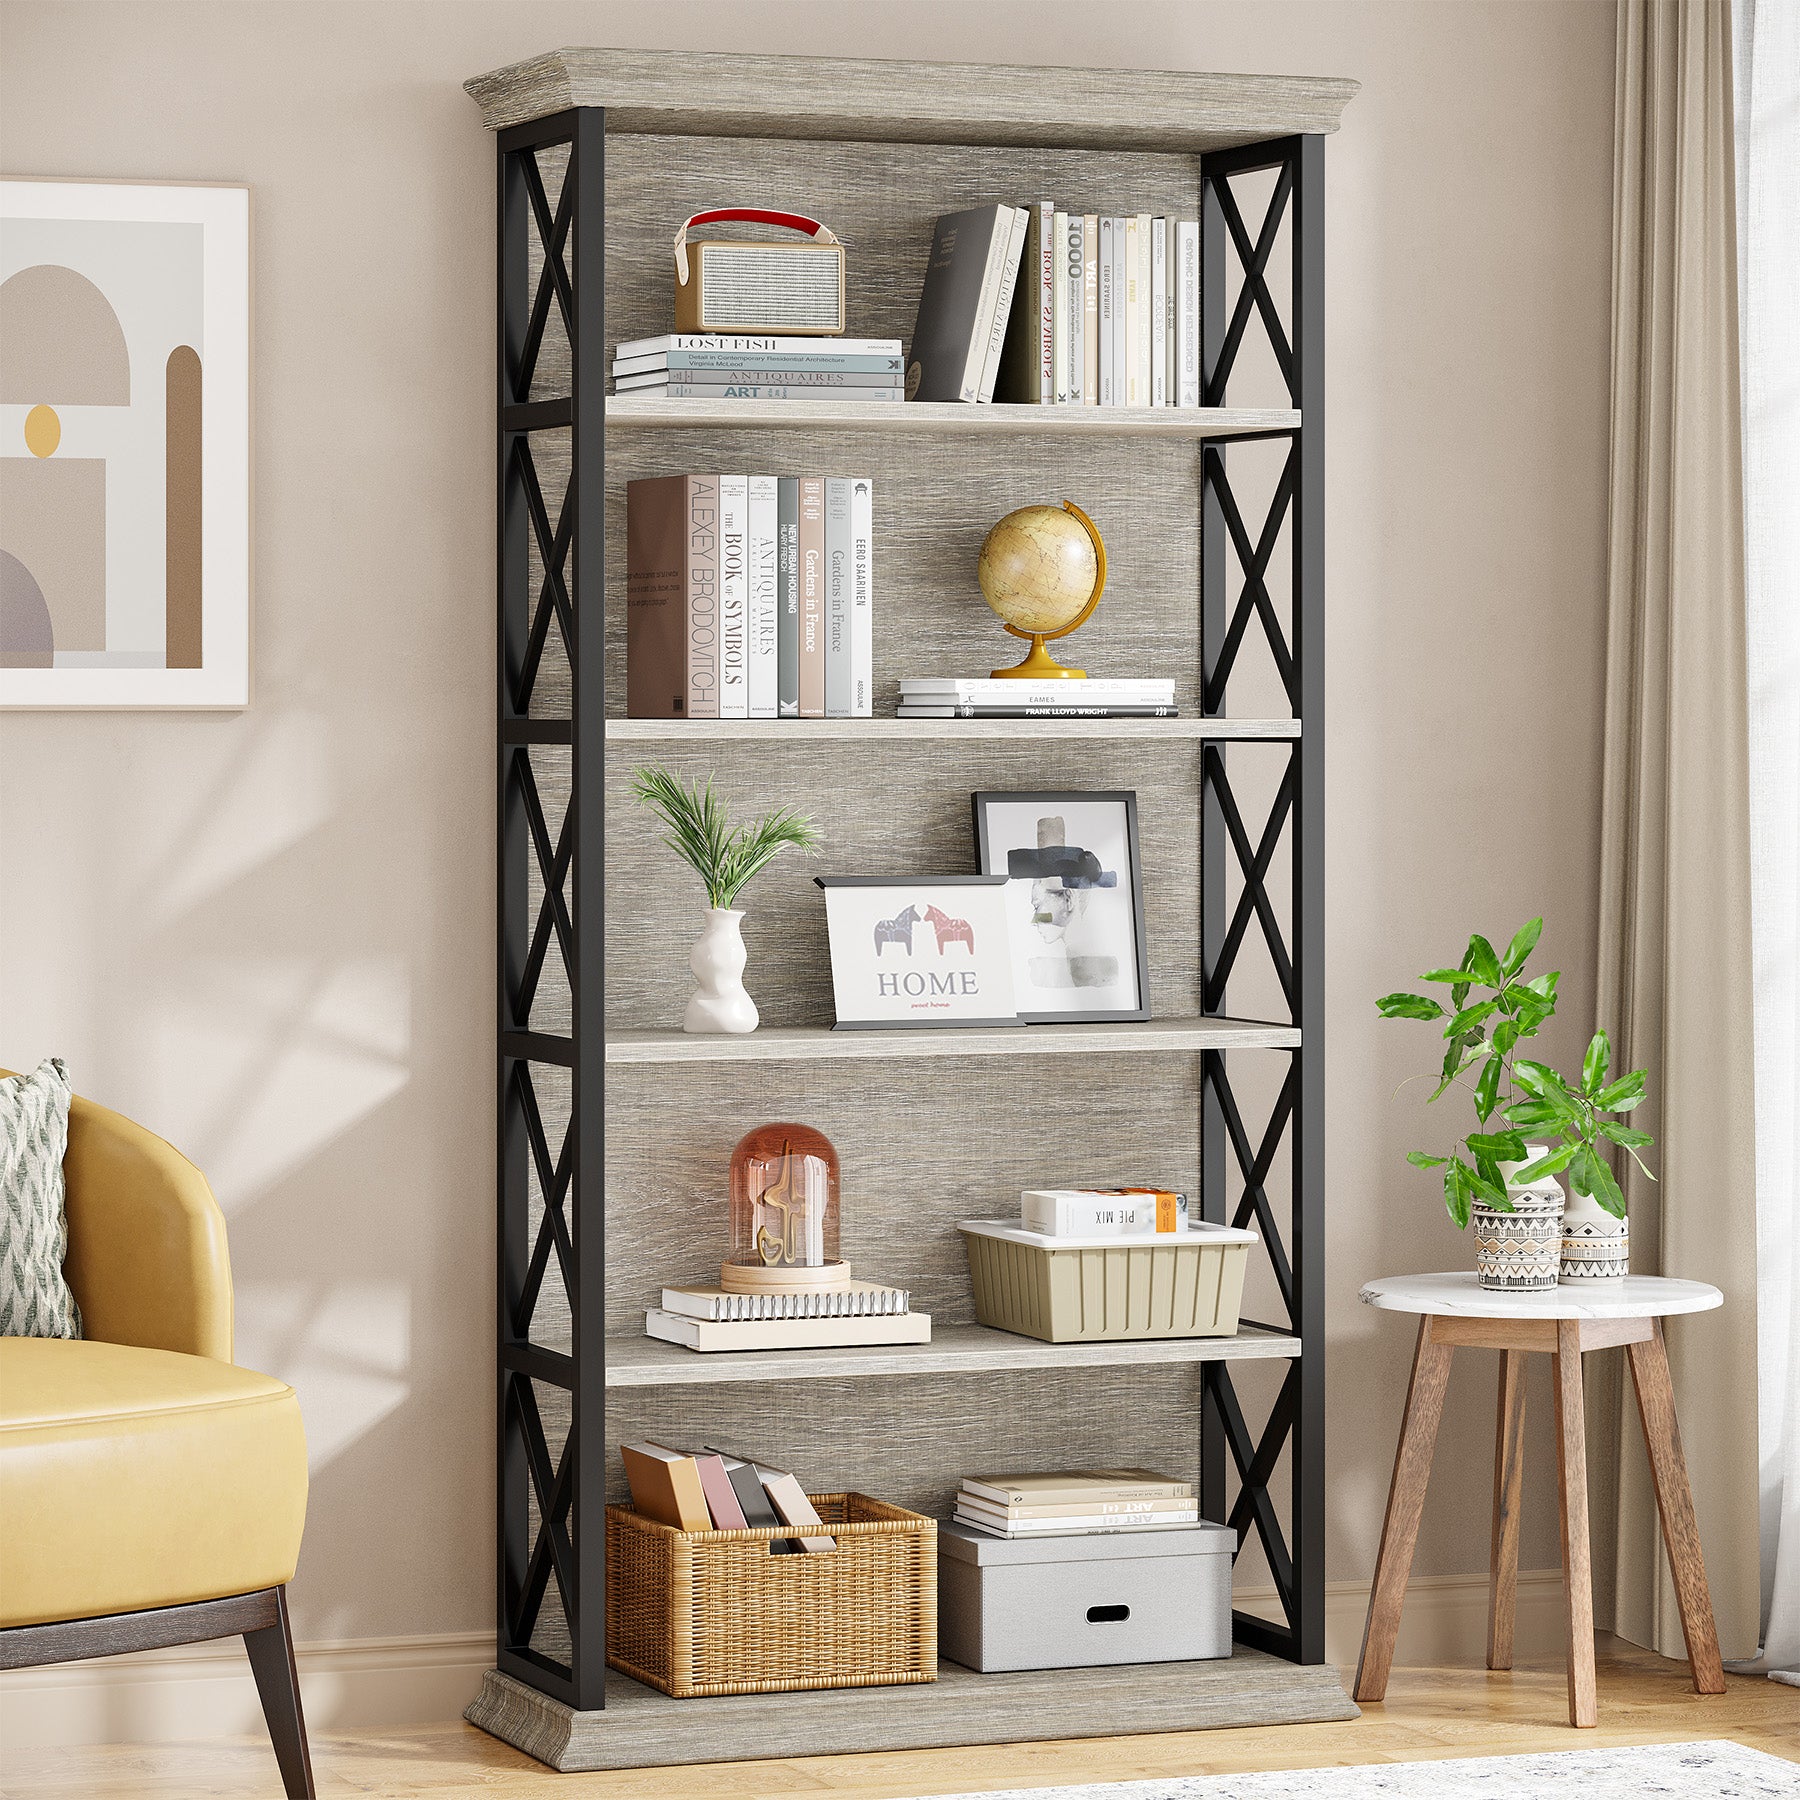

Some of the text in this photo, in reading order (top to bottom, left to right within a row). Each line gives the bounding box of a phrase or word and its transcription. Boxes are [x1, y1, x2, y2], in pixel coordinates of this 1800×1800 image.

[678, 338, 776, 350] LOST FISH
[724, 386, 760, 397] ART
[729, 371, 844, 381] ANTIQUAIRES
[780, 524, 788, 572] HILARY FRENCH
[788, 524, 797, 614] NEW URBAN HOUSING
[691, 480, 714, 702] ALEXEY BRODOVITCH
[756, 537, 775, 656] ANTIQUAIRES
[856, 539, 866, 606] EERO SAARINEN
[724, 512, 743, 685] THE BOOK OF SYMBOLS
[805, 549, 819, 653] Gardens in France
[831, 550, 845, 652] Gardens in France
[877, 971, 979, 997] HOME
[1095, 1210, 1135, 1224] PIE MIX
[1123, 1502, 1154, 1512] ART
[1123, 1514, 1153, 1524] ART
